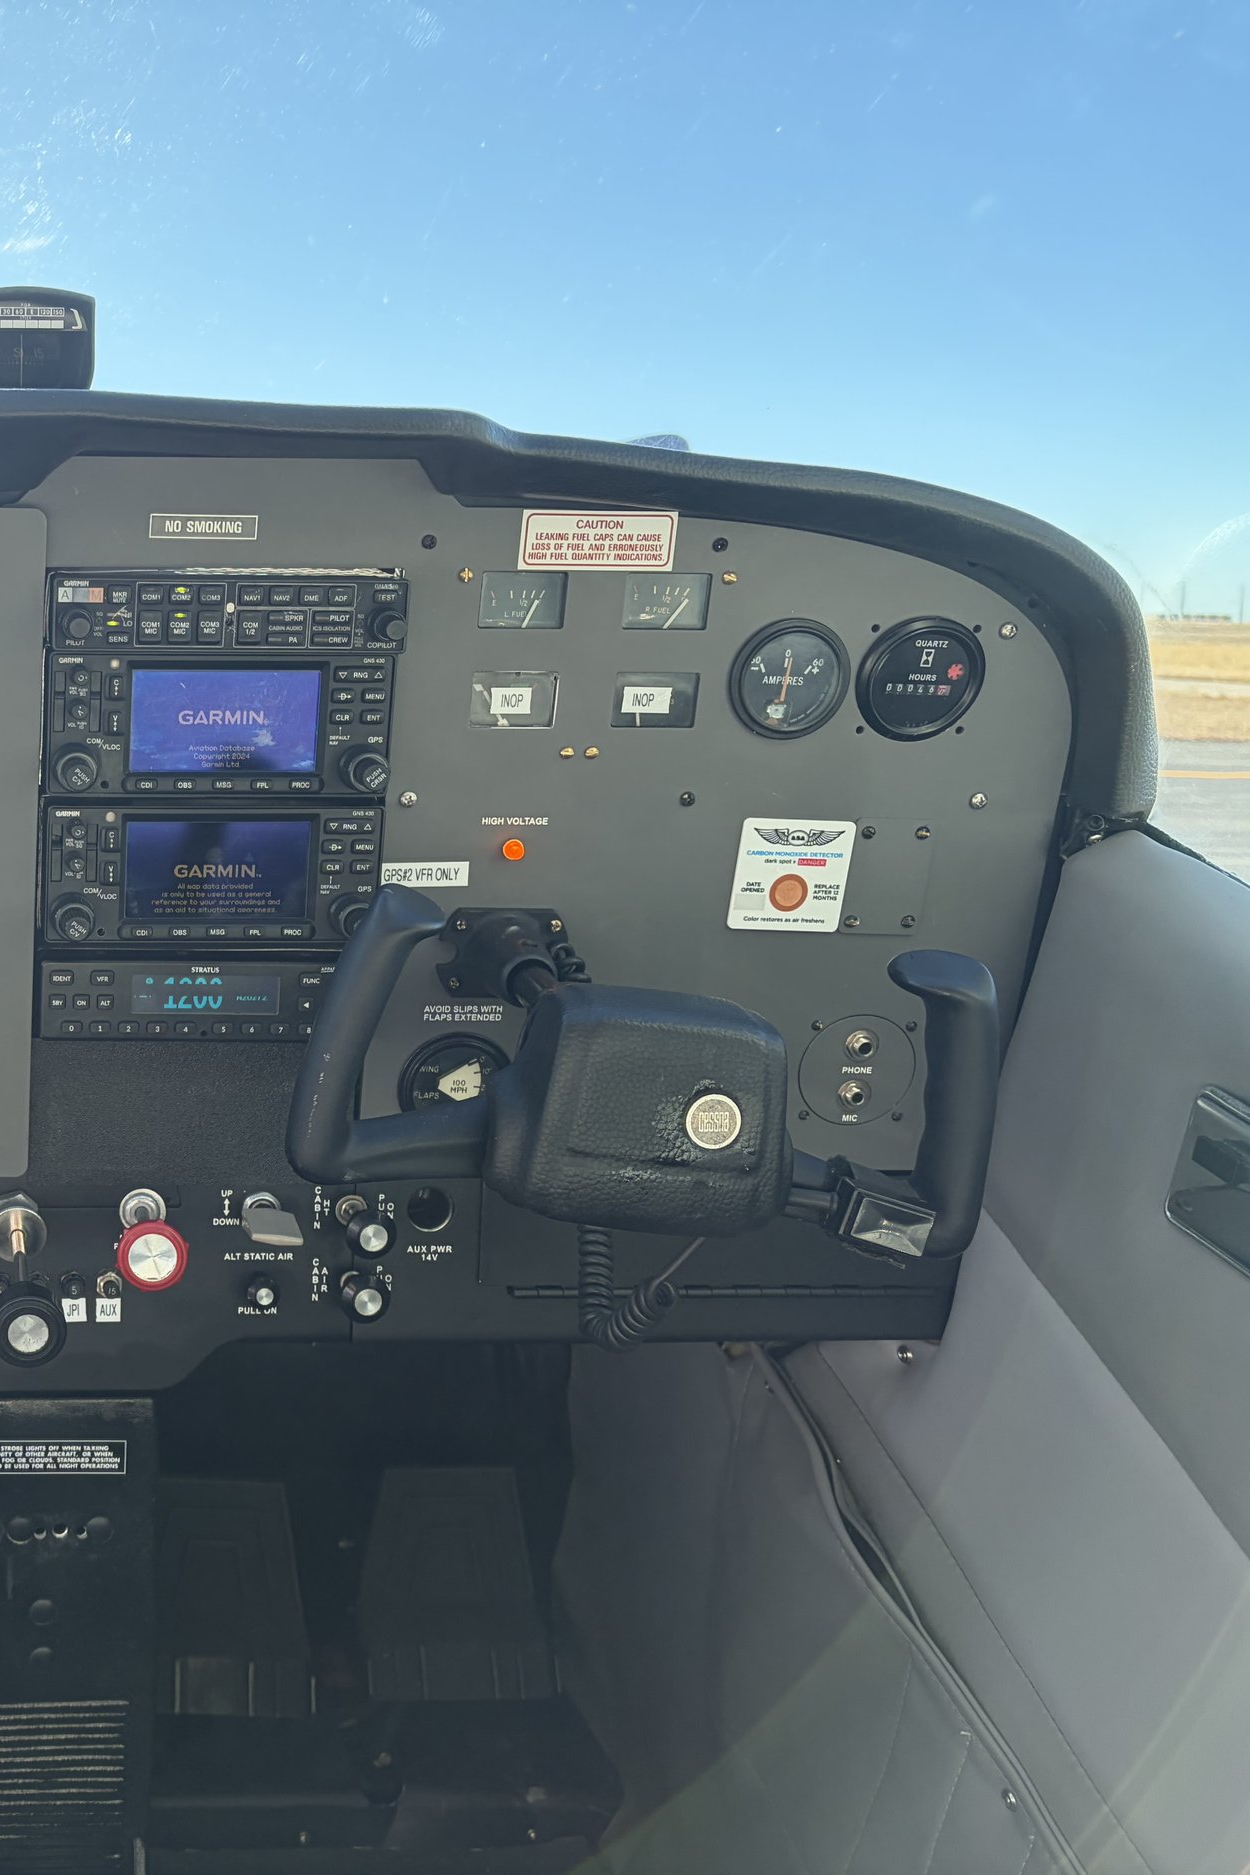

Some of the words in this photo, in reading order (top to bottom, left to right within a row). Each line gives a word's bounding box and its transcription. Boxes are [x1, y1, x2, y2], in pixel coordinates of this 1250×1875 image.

[165, 520, 182, 533] NO
[186, 520, 243, 534] SMOKING
[576, 519, 624, 530] CAUTION
[535, 532, 570, 542] LEAKING
[572, 533, 591, 542] FUEL
[593, 533, 615, 542] CAPS
[617, 533, 635, 543] CAN
[636, 533, 662, 543] CAUSE
[531, 542, 552, 551] LOSS
[554, 542, 565, 551] OF
[566, 542, 586, 552] FUEL
[588, 543, 606, 552] AND
[607, 543, 664, 553] ERRONEOUSLY
[528, 551, 547, 561] HIGH
[549, 552, 569, 561] FUEL
[571, 552, 611, 562] QUANTITY
[613, 552, 665, 562] INDICATIONS.
[915, 640, 949, 648] QUARTZ
[762, 676, 804, 686] AMPERES
[908, 673, 937, 682] HOURS
[501, 694, 524, 708] INOP
[632, 693, 655, 707] INOP
[178, 710, 264, 725] GARMIN
[481, 817, 504, 826] HIGH
[506, 817, 549, 826] VOLTAGE
[174, 865, 255, 878] GARMIN
[383, 868, 413, 882] GPS#2
[414, 868, 433, 881] VFR
[435, 867, 460, 881] ONLY
[191, 966, 220, 974] STRATUS
[303, 977, 320, 985] FUNC
[424, 1005, 451, 1013] AVOID
[453, 1005, 478, 1013] SLIPS
[481, 1005, 503, 1013] WITH
[841, 1066, 872, 1075] PHONE
[841, 1114, 858, 1122] MIC
[221, 1189, 233, 1197] UP
[213, 1218, 240, 1226] DOWN
[407, 1245, 427, 1253] AUX
[430, 1245, 452, 1253] PWR
[243, 1252, 275, 1261] STATIC
[277, 1252, 293, 1261] AIR
[421, 1253, 438, 1262] 14V
[67, 1303, 80, 1317] JPI
[100, 1303, 117, 1317] AUX
